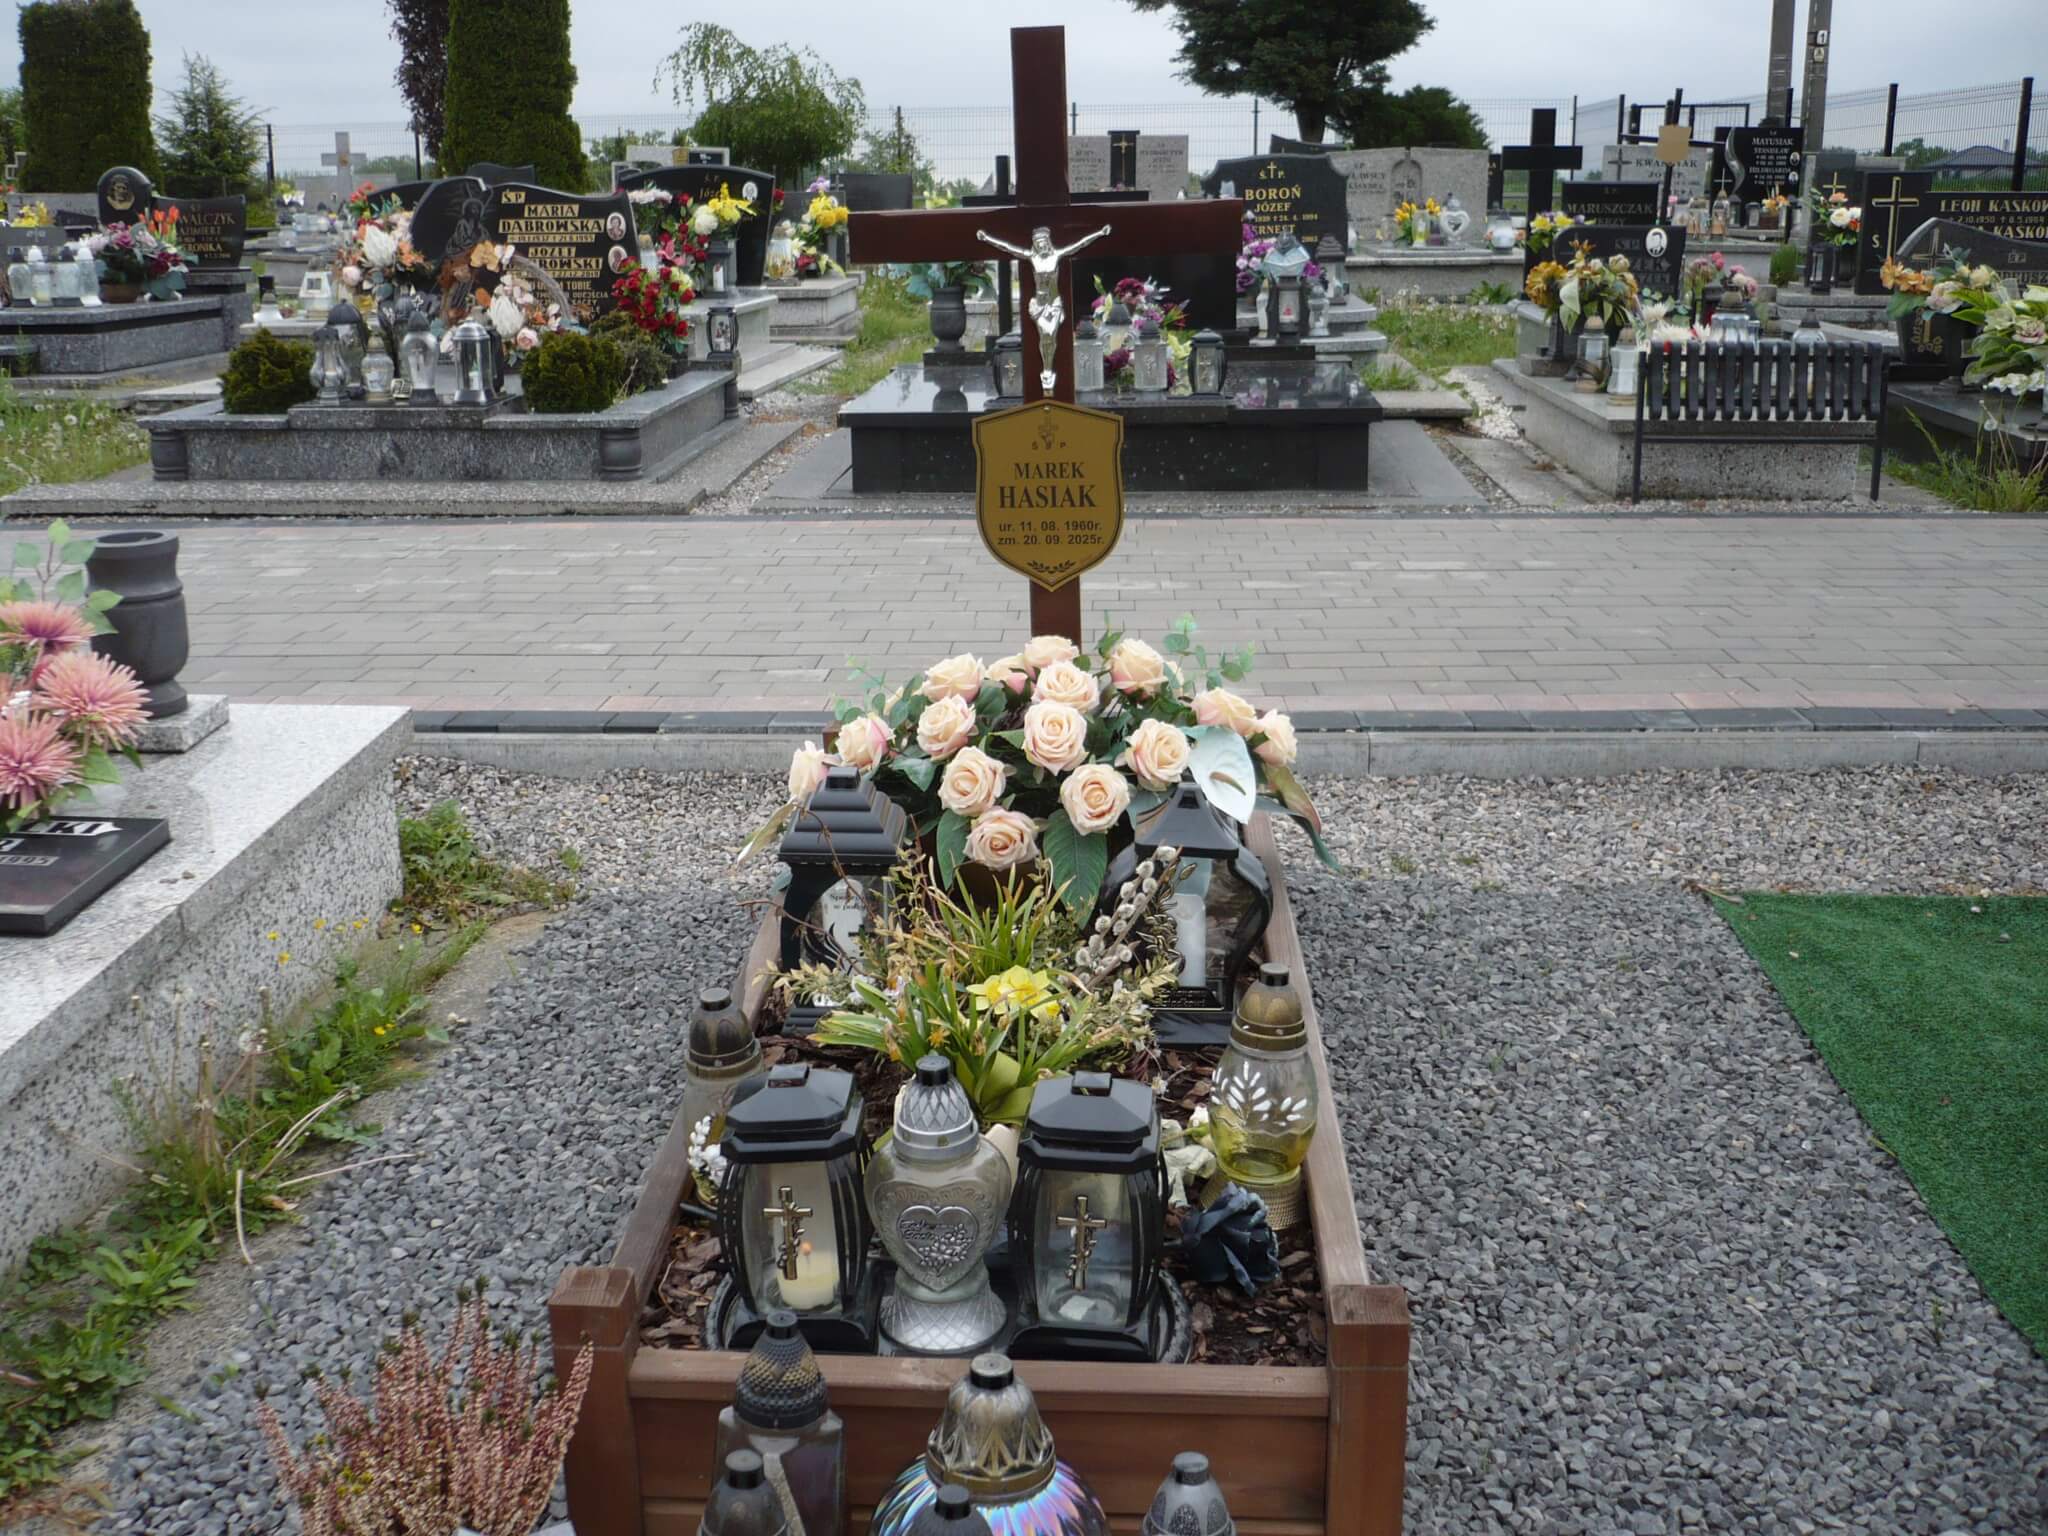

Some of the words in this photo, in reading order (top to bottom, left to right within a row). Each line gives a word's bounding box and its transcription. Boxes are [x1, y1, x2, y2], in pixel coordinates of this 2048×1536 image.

[1245, 184, 1301, 200] BOROŃ
[527, 205, 576, 216] MARIA
[1254, 201, 1291, 212] JÓZEF
[1014, 462, 1085, 479] MAREK
[999, 484, 1097, 508] HASIAK
[999, 522, 1015, 532] ur.
